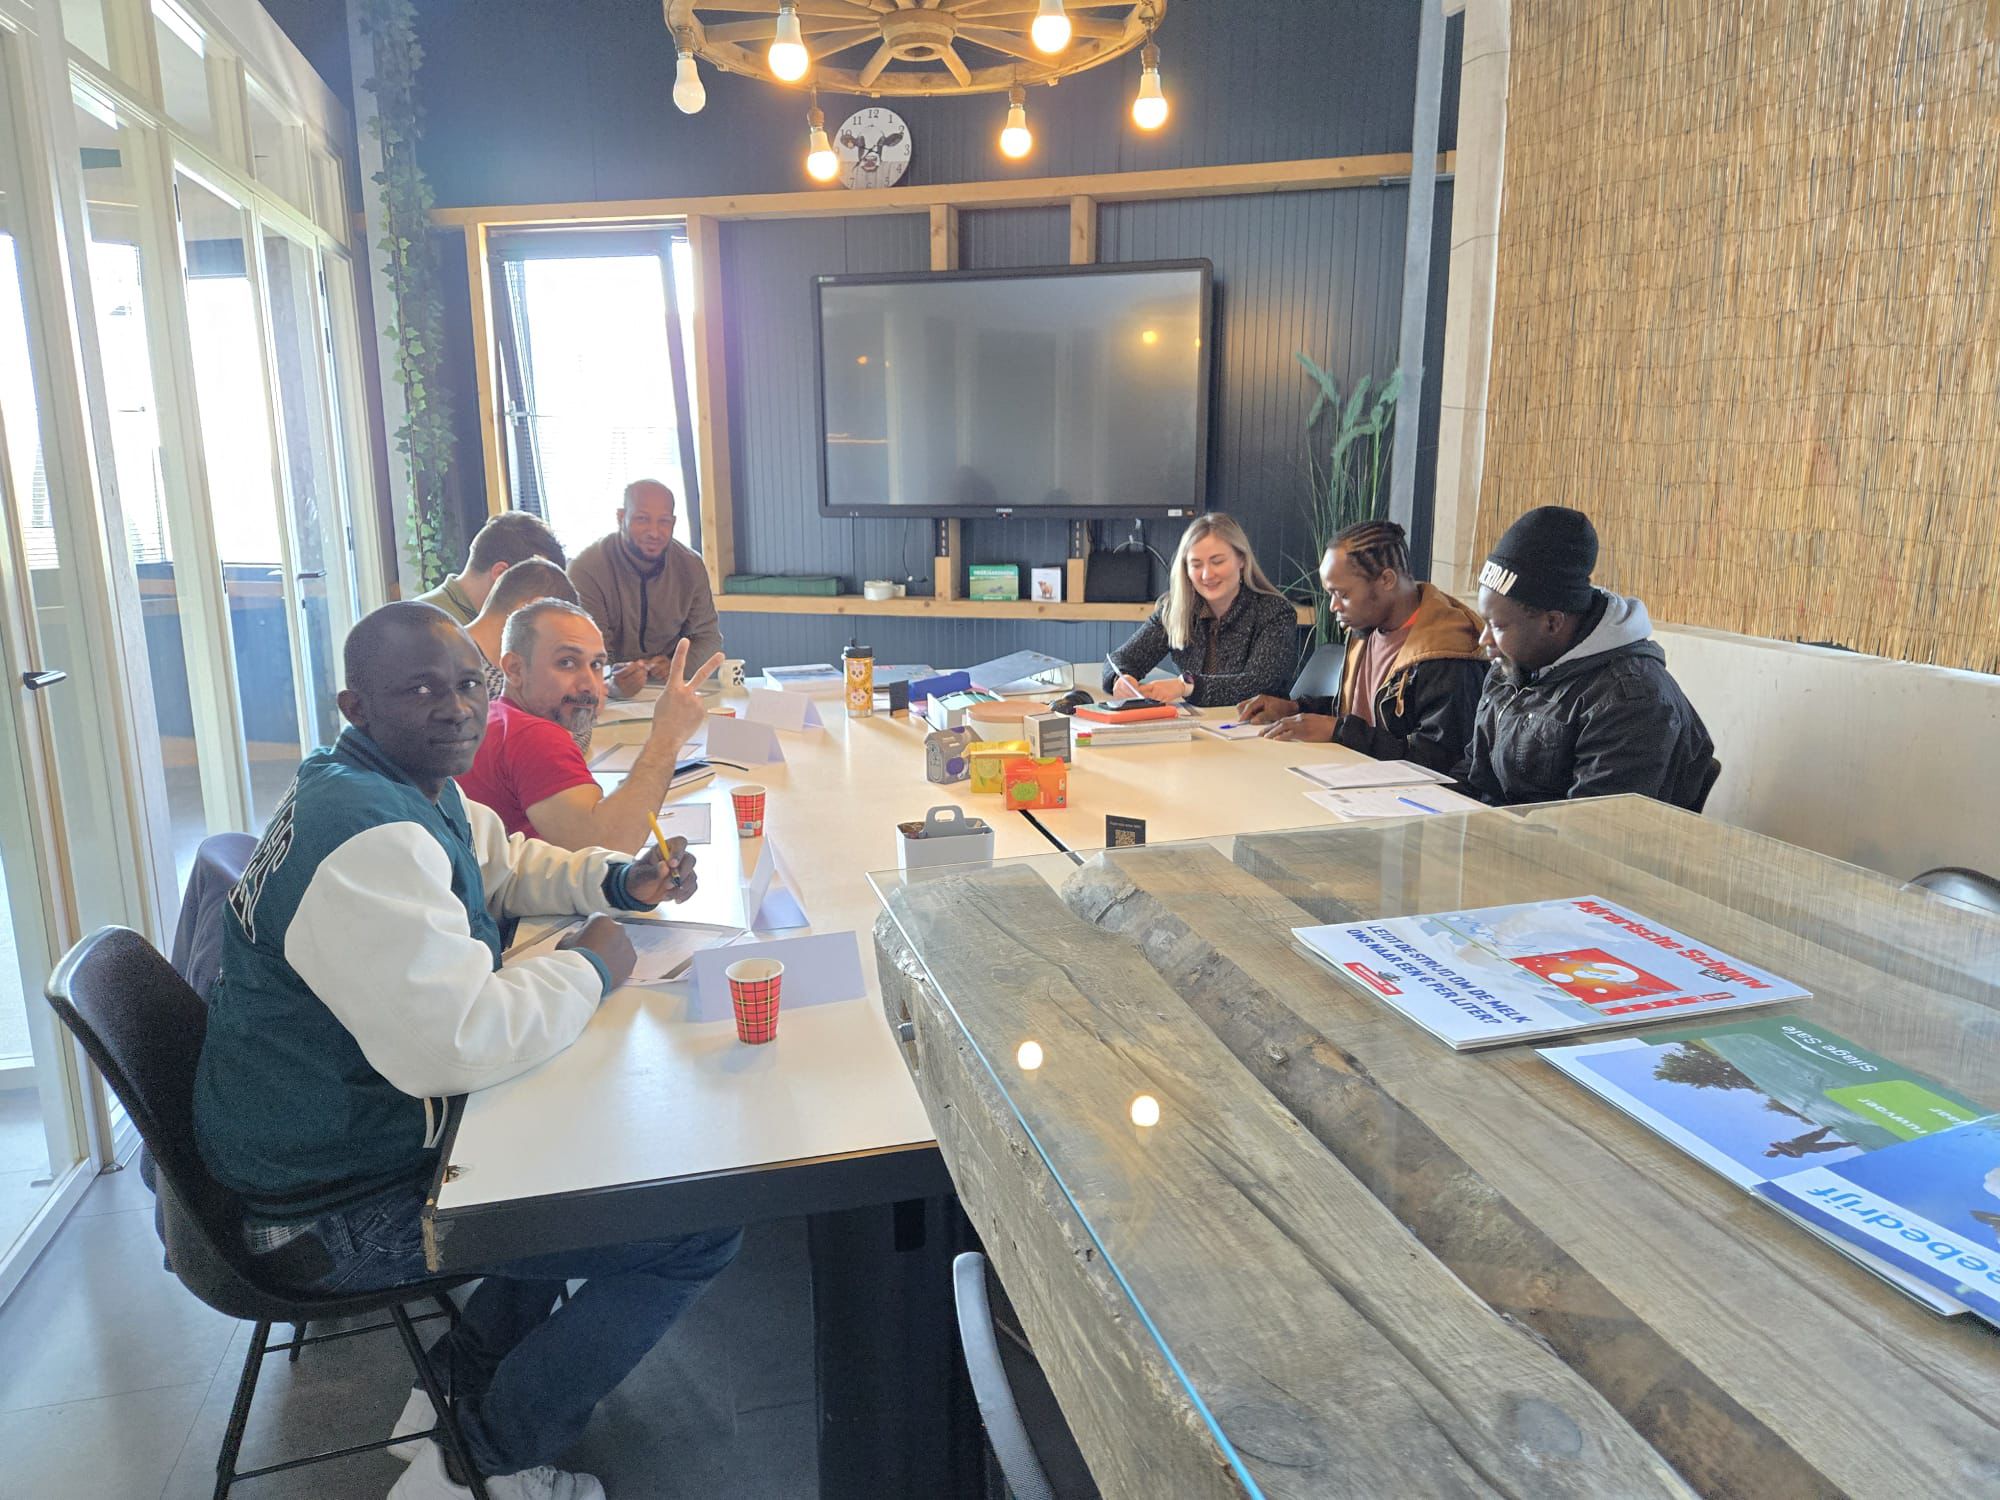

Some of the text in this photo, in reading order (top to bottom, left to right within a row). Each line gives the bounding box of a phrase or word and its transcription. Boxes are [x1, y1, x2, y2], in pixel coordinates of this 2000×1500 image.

[868, 109, 880, 119] 12
[888, 114, 893, 124] 1
[853, 116, 862, 126] 11
[898, 125, 905, 135] 2
[904, 144, 910, 156] 3
[896, 163, 903, 174] 4
[849, 177, 855, 188] 7
[1367, 926, 1533, 1023] LEIDT DE STRIJD OM DE MELK
[1676, 949, 1774, 989] Schouw
[1346, 930, 1375, 943] ONS
[1366, 944, 1403, 963] NAAR
[1395, 963, 1427, 976] EEN
[1426, 983, 1458, 998] PER
[1450, 999, 1503, 1023] LITER?
[1781, 1025, 1878, 1072] Silage Safe
[1856, 1098, 1928, 1135] ruwvoer
